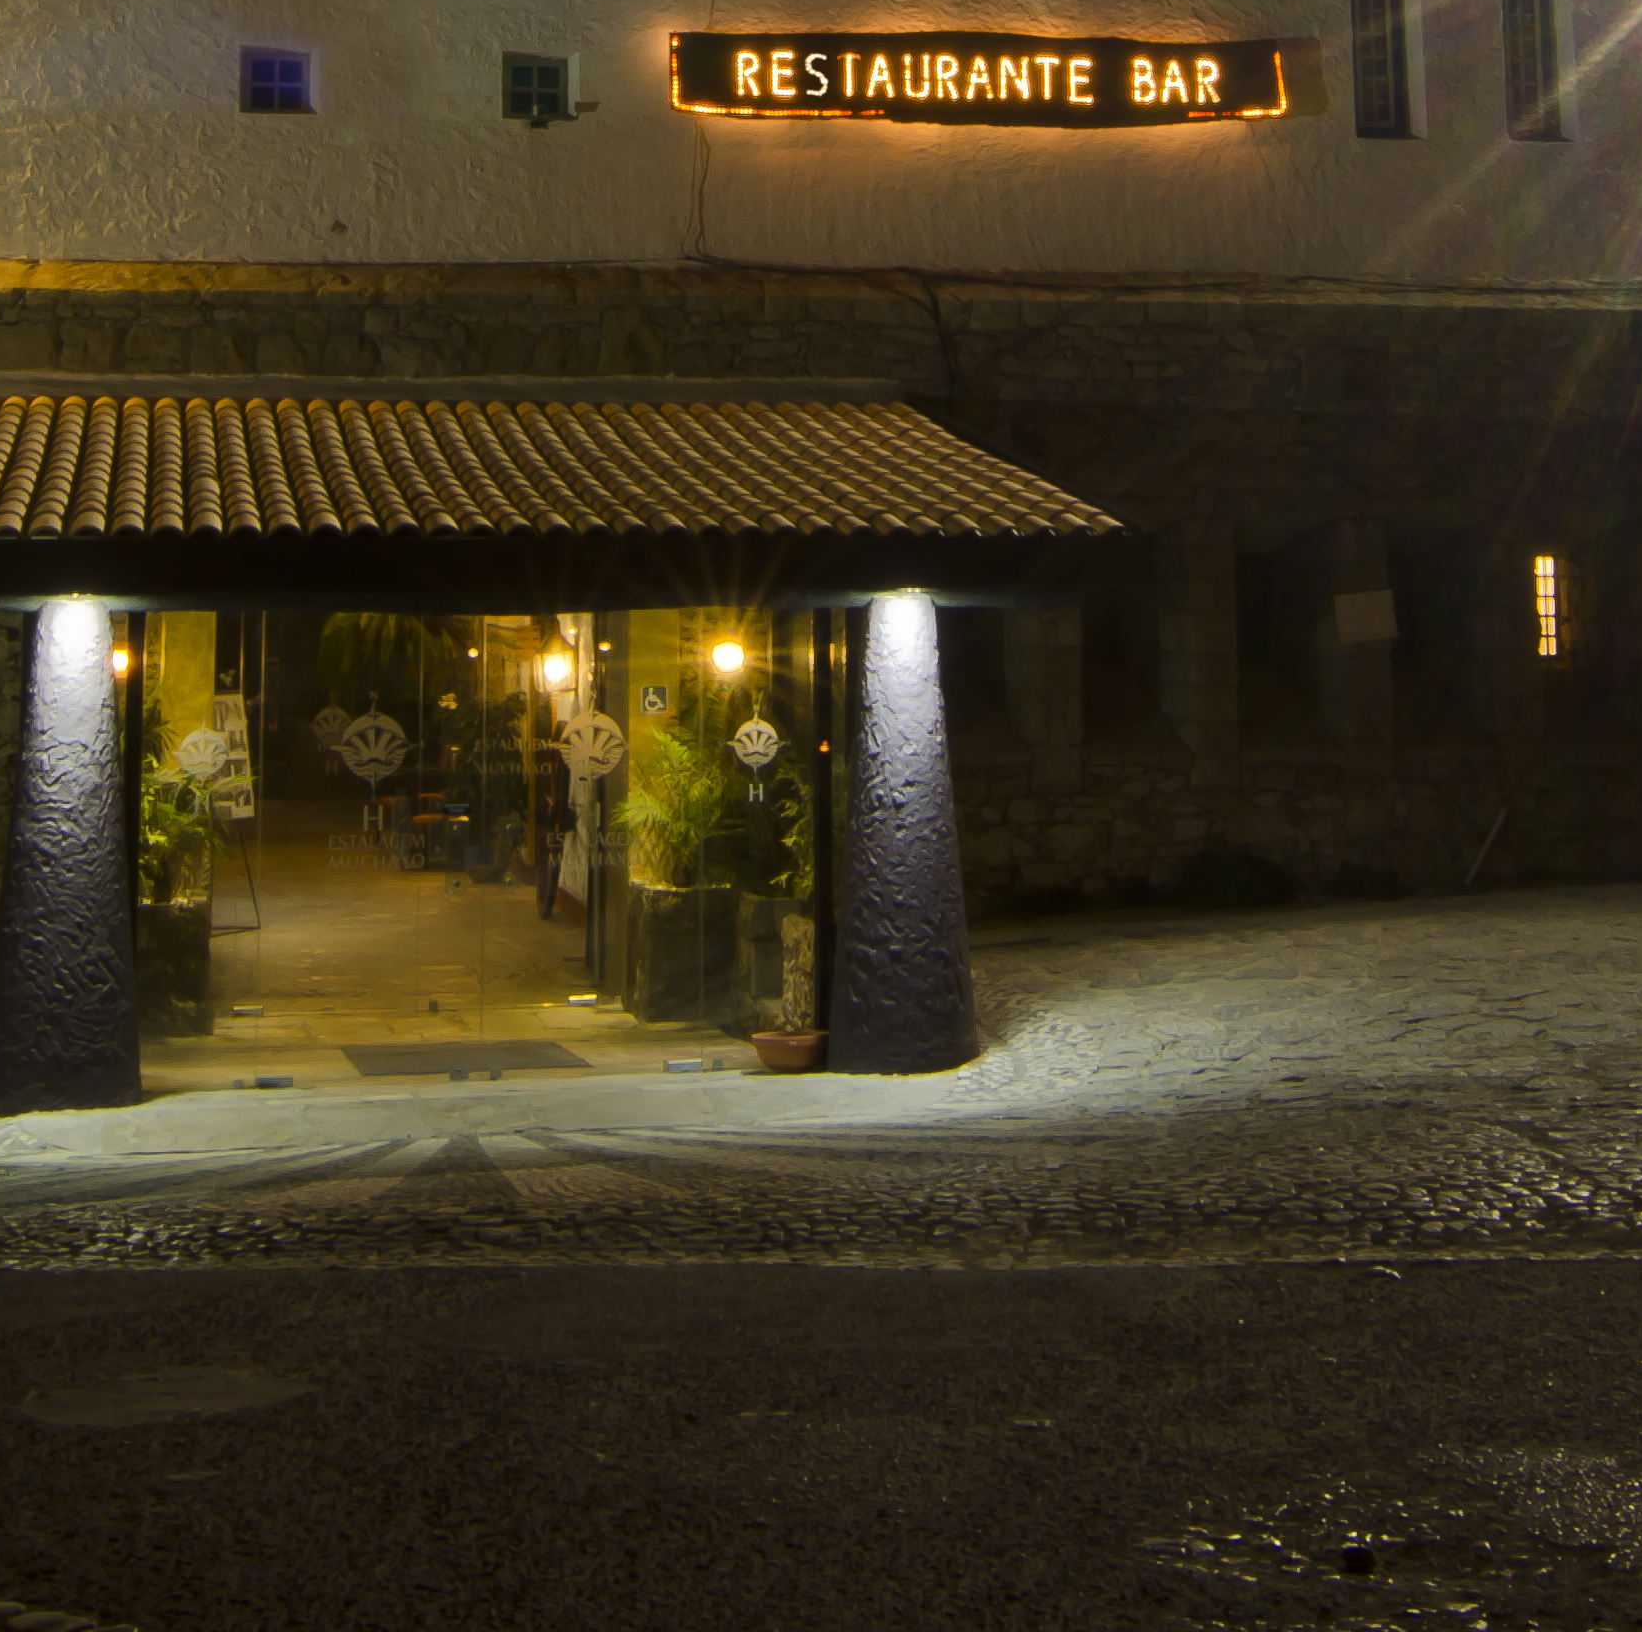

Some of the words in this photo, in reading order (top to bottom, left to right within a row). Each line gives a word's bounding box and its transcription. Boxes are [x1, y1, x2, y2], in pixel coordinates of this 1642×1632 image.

[735, 50, 1094, 105] RESTAURANTE
[1130, 57, 1222, 105] BAR
[748, 783, 764, 802] H
[362, 805, 384, 831] H
[328, 833, 425, 850] ESTALAGEM
